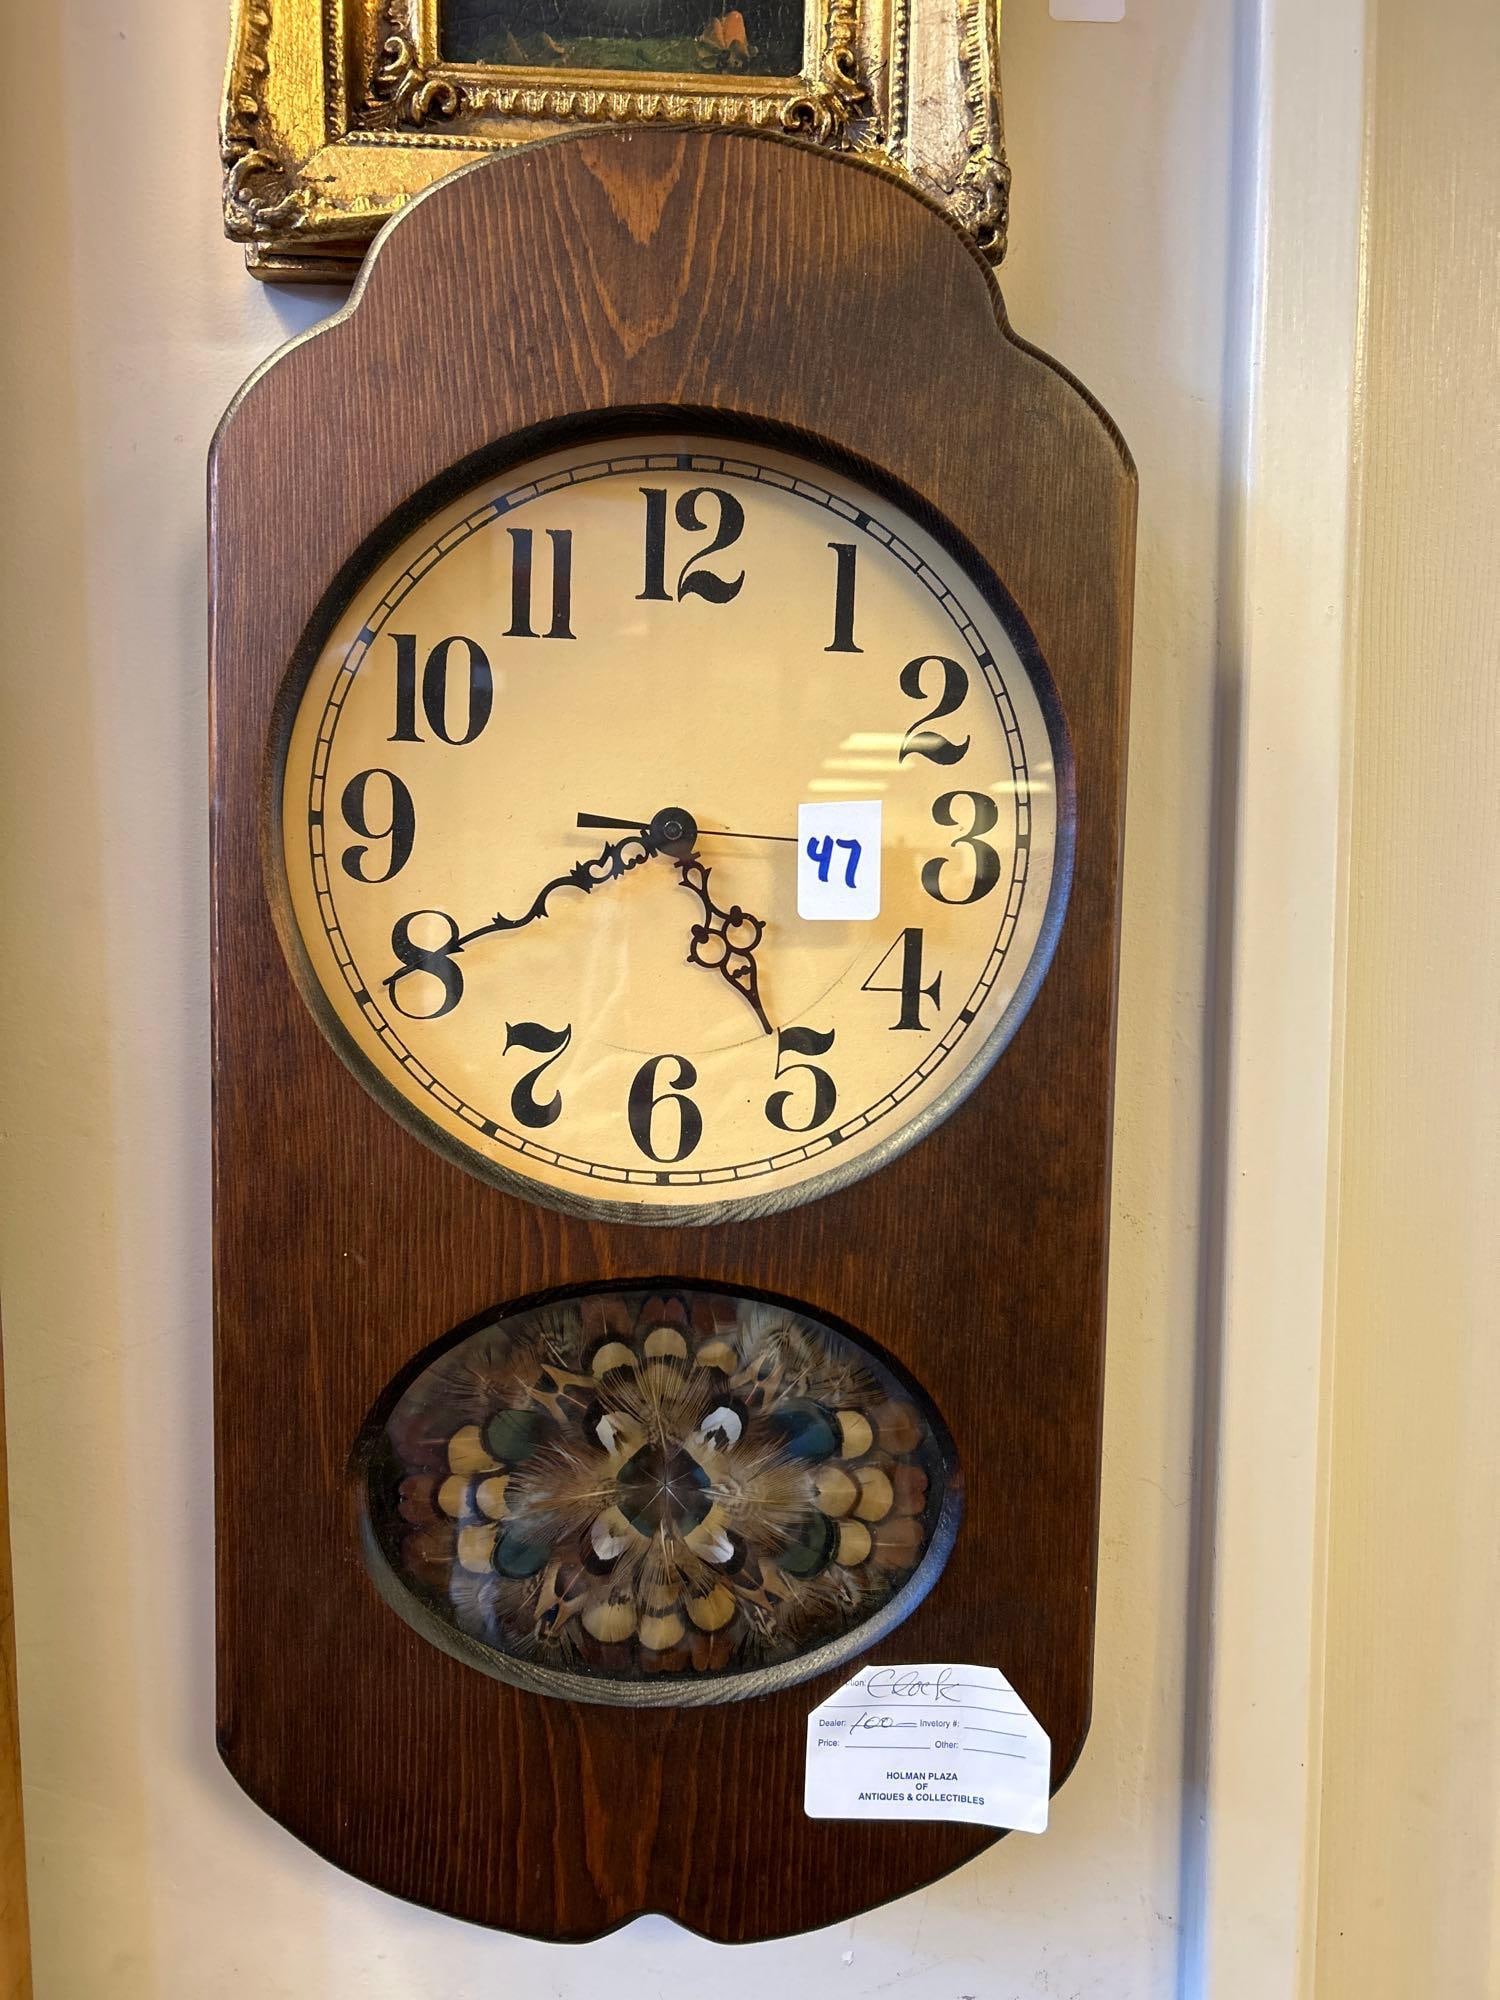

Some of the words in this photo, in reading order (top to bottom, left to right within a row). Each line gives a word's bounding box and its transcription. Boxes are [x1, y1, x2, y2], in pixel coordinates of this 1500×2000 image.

[502, 528, 577, 639] 11
[635, 487, 746, 603] 12
[824, 542, 864, 652] 1
[387, 633, 494, 745] 10
[898, 655, 970, 765] 2
[340, 768, 415, 883] 9
[806, 834, 862, 888] 47
[921, 791, 1000, 904] 3
[387, 909, 466, 1019] 8
[860, 927, 942, 1031] 4
[503, 1022, 571, 1128] 7
[628, 1053, 703, 1163] 6
[765, 1026, 836, 1132] 5
[819, 1719, 847, 1727] Dealer:
[867, 1668, 960, 1702] Clock
[920, 1719, 950, 1728] Invetory
[818, 1739, 840, 1747] Price:
[887, 1772, 926, 1780] HOLMAN
[928, 1773, 958, 1781] PLAZA
[935, 1741, 959, 1749] Other:
[859, 1793, 905, 1802] ANTIQUES
[916, 1793, 984, 1805] COLLECTIBLES
